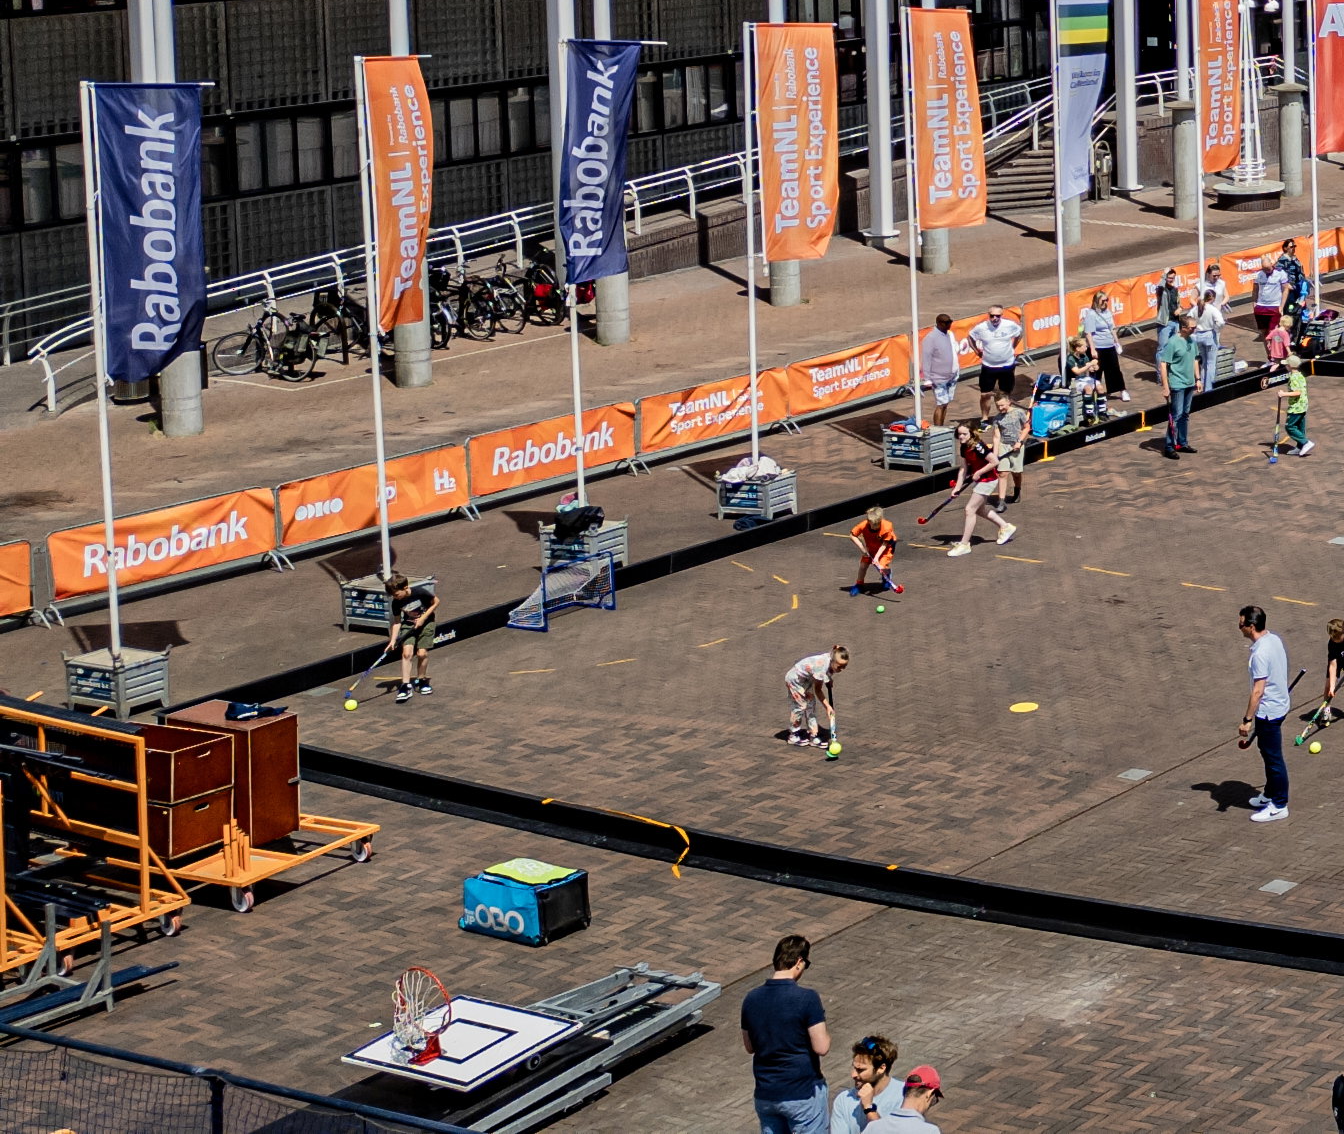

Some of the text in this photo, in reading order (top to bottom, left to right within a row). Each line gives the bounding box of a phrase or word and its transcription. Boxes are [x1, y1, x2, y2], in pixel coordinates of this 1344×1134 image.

[390, 86, 408, 144] Rabobank
[784, 48, 798, 99] Rabobank
[949, 31, 981, 200] Sport Experience
[1206, 55, 1223, 151] TeamNL
[1220, 0, 1237, 146] Sport Experience
[404, 84, 433, 214] Experience
[563, 60, 618, 257] Rabobank
[772, 115, 800, 234] TeamNL
[803, 47, 831, 229] Sport Experience
[927, 93, 953, 205] TeamNL
[124, 108, 182, 351] Rabobank
[389, 161, 419, 300] TeamNL
[669, 390, 730, 417] TeamNL
[670, 414, 703, 435] Sport
[809, 354, 862, 384] TeamNL
[812, 367, 891, 400] Sport Experience
[475, 903, 525, 935] OBO
